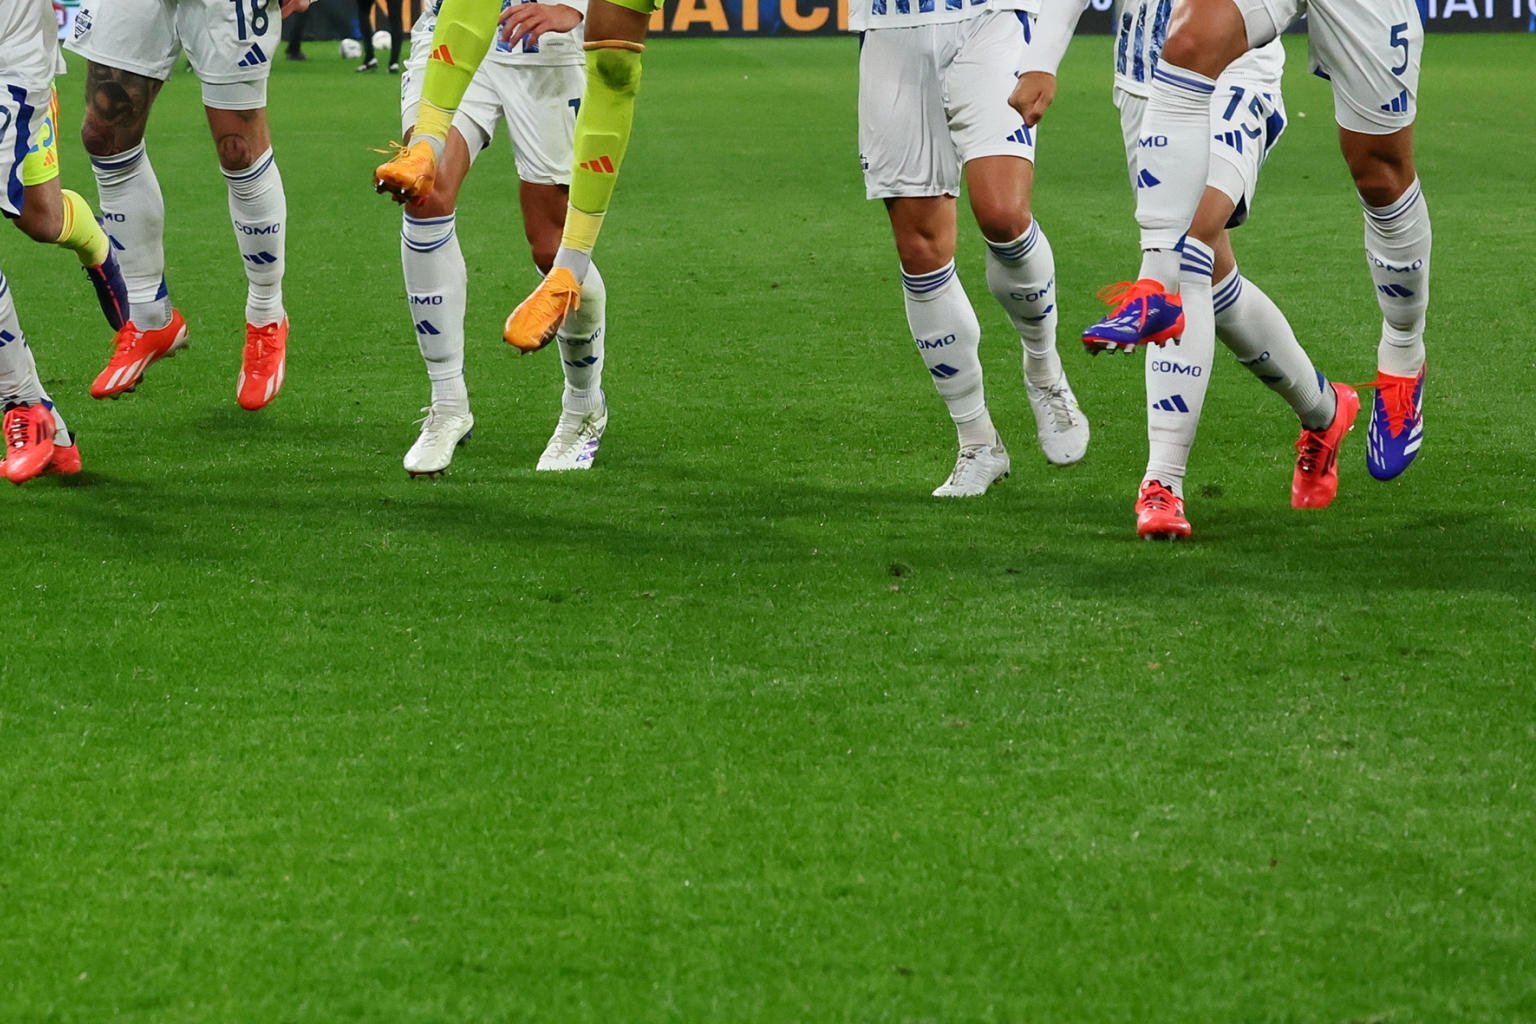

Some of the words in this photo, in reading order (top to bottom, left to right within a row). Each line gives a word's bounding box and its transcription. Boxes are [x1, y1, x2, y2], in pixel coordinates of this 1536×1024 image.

[1390, 22, 1409, 76] 5
[1138, 135, 1168, 148] MO
[104, 213, 125, 223] MO
[234, 221, 280, 235] COMO
[916, 333, 956, 350] OMO
[1151, 360, 1202, 378] COMO
